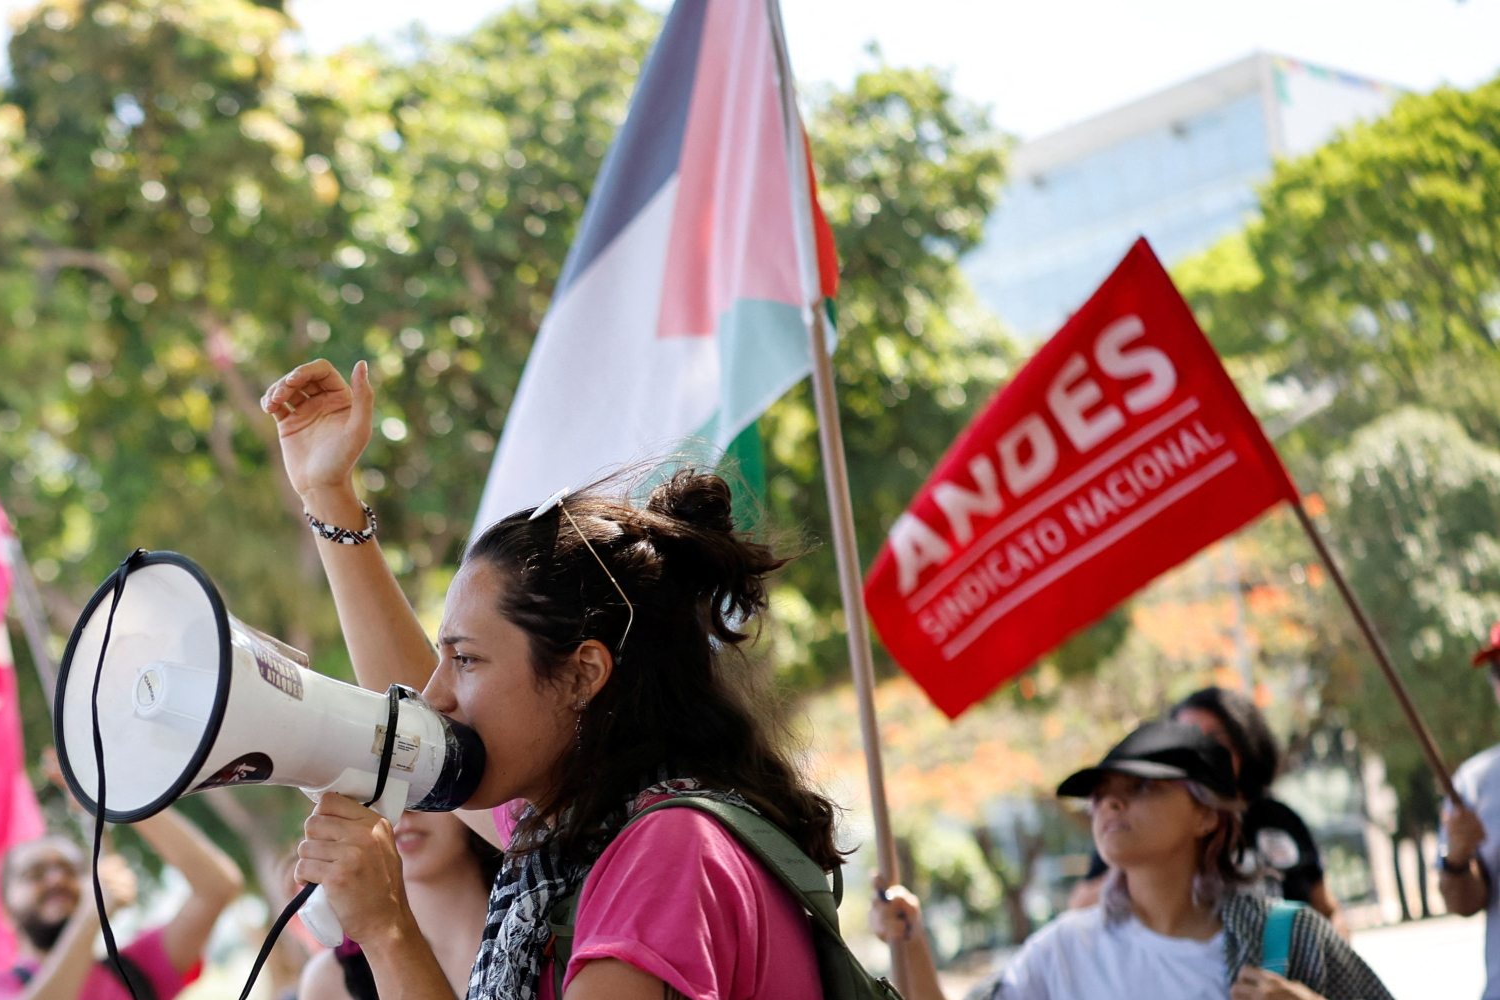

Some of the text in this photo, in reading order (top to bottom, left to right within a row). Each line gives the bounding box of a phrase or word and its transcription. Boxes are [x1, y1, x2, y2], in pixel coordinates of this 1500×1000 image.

[889, 314, 1178, 594] ANDES
[917, 420, 1225, 645] SINDICATO NACIONAL
